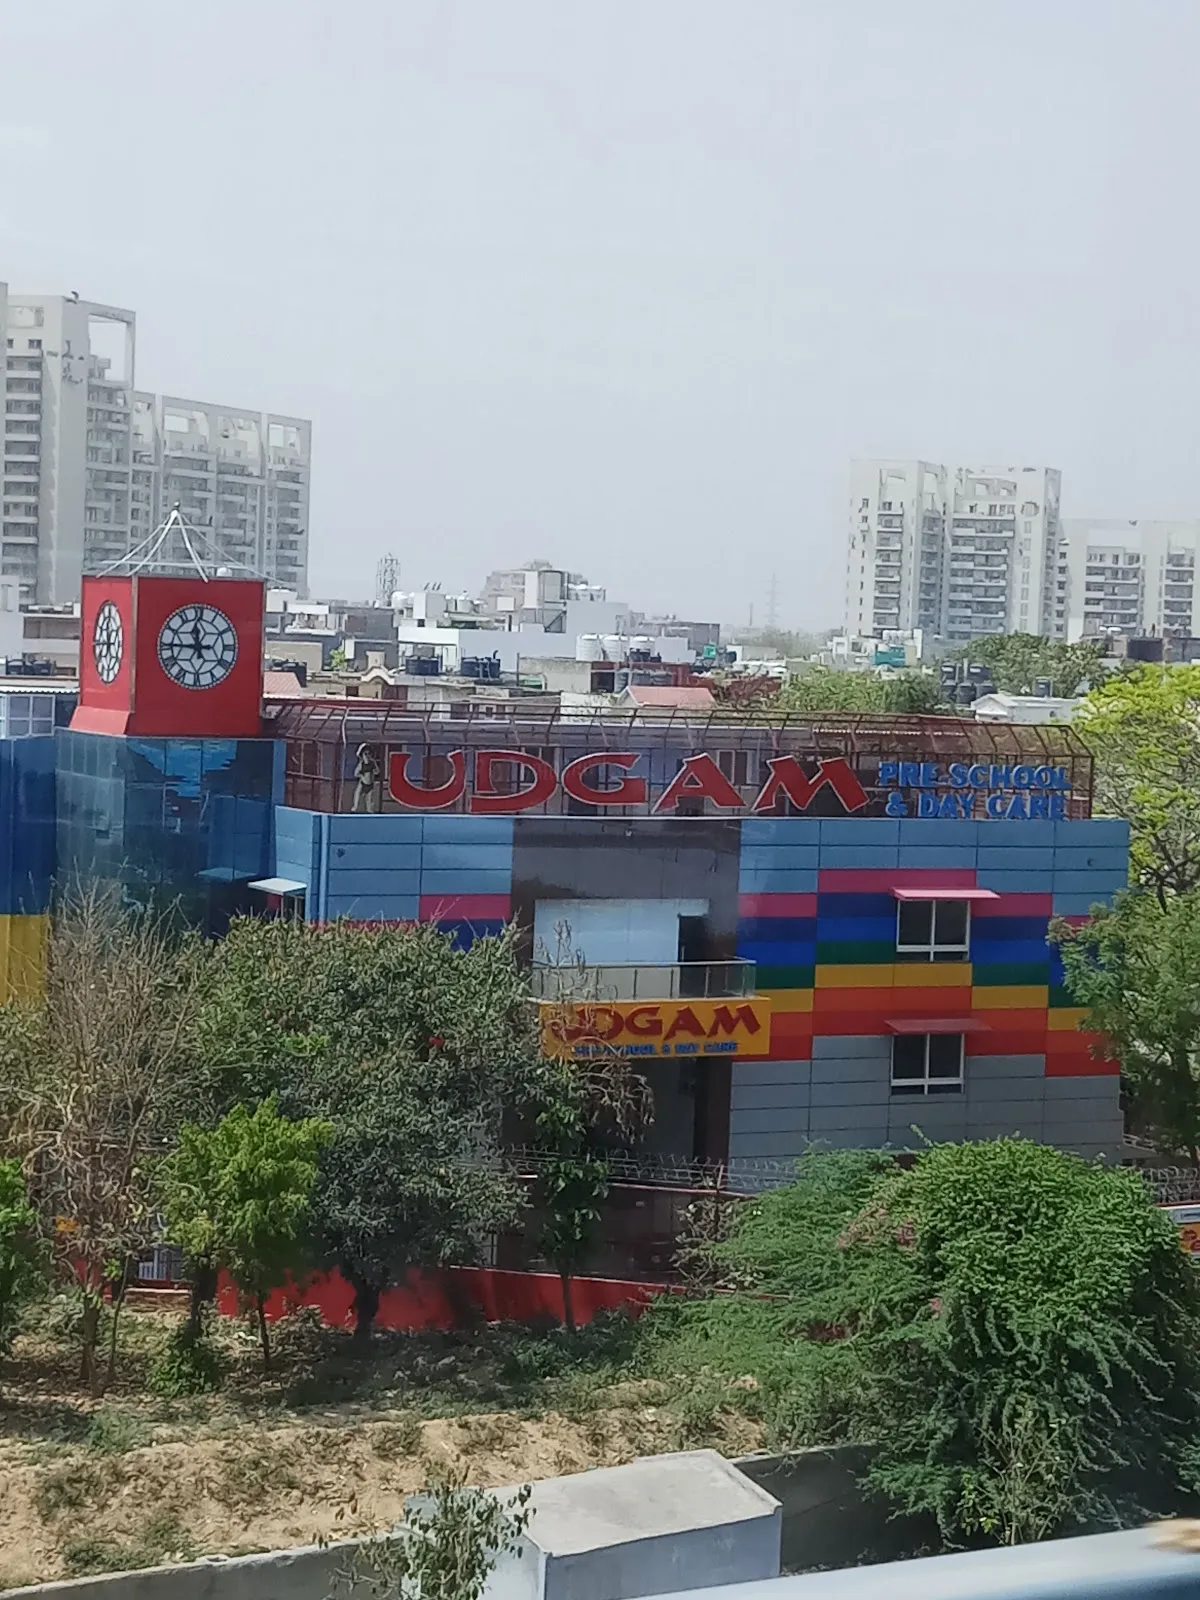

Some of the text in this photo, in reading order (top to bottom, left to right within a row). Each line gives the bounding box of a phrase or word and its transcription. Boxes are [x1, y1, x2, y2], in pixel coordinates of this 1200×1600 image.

[389, 749, 869, 814] UDGAM
[885, 791, 1069, 821] & DAY CARE
